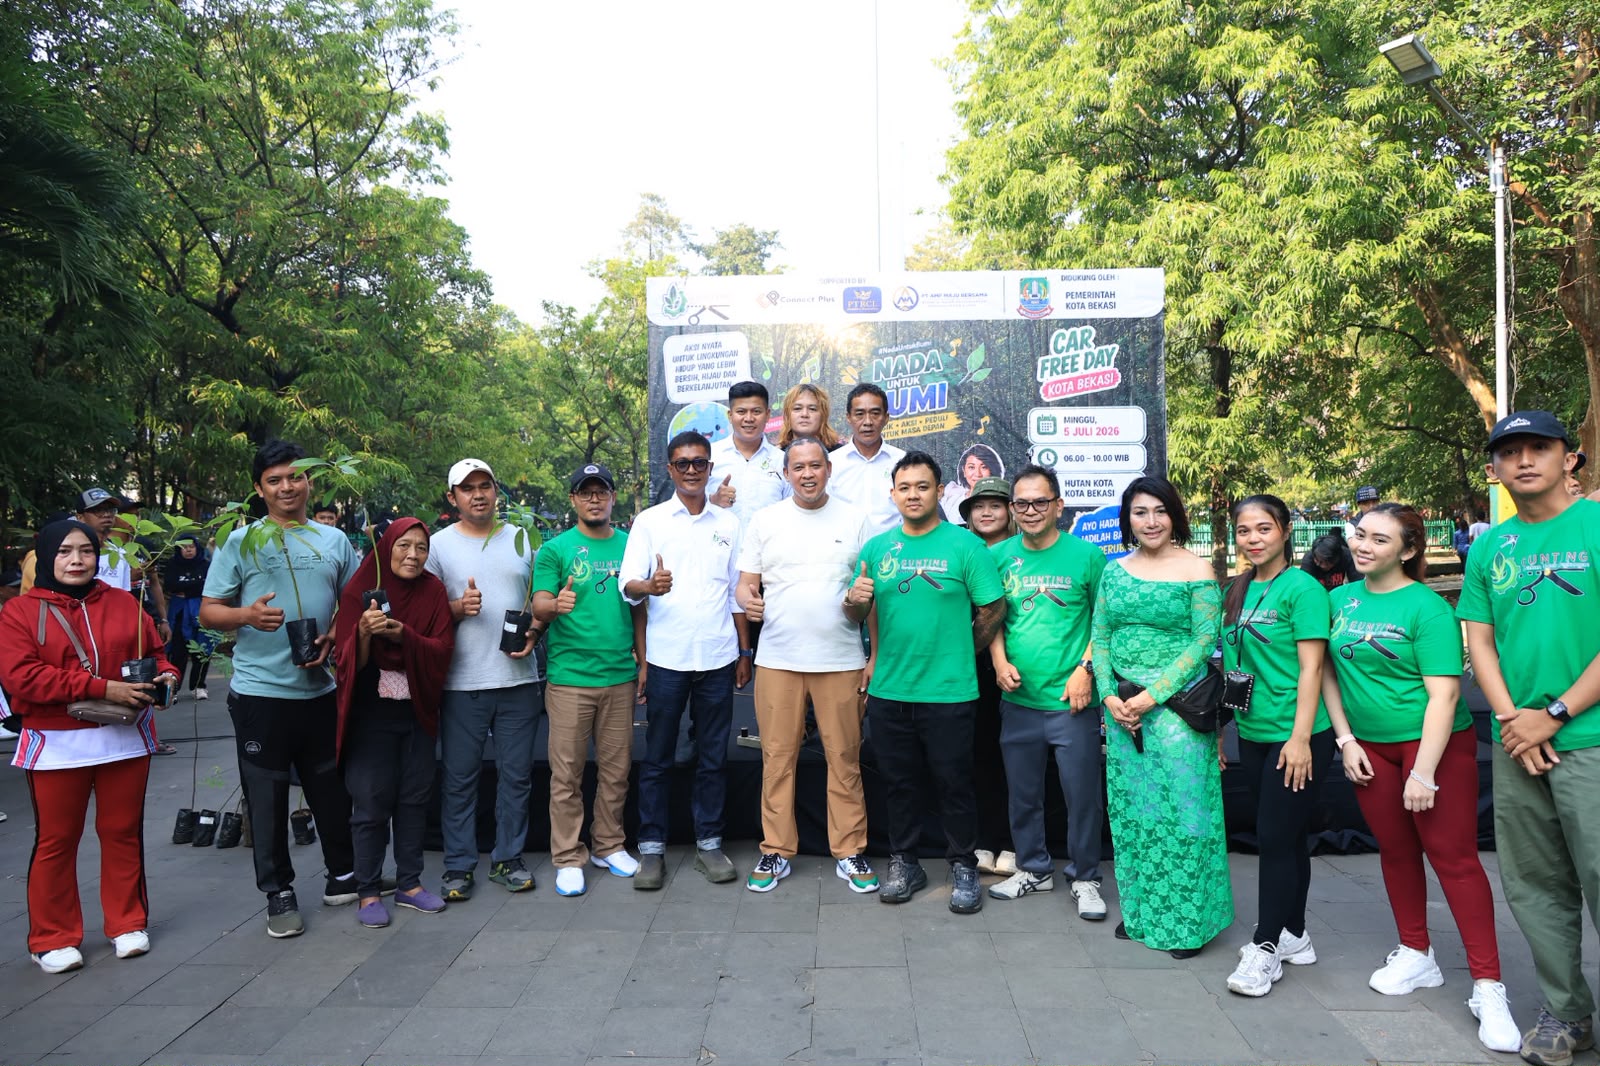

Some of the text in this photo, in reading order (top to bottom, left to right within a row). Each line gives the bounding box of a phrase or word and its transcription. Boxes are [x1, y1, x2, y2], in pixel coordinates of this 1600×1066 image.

[1060, 274, 1096, 282] DIDUKUNG
[1098, 273, 1115, 281] OLEH
[818, 295, 835, 303] Plus
[1065, 291, 1116, 299] PEMERINTAH
[1065, 301, 1117, 310] KOTA BEKASI
[684, 341, 722, 352] AKSI NYATA
[1053, 328, 1092, 355] CAR
[672, 350, 739, 363] UNTUK LINGKUNGAN
[675, 360, 736, 373] HIDUP YANG LEBIH
[873, 350, 943, 382] NADA
[1039, 346, 1116, 379] FREE DAY
[674, 370, 737, 383] BERSIH, HIJAU DAN
[887, 375, 921, 389] UNTUK
[676, 381, 732, 393] BERKELANJUTAN
[1047, 372, 1114, 397] KOTA BEKASI
[886, 381, 949, 418] UMI
[901, 419, 917, 427] AKSI
[925, 414, 949, 424] PEDULI
[1063, 416, 1097, 424] MINGGU,
[881, 423, 945, 438] NTUK MASA DEPAN
[1063, 426, 1120, 437] 5 JULI 2026
[1063, 454, 1085, 462] 06.00
[1093, 454, 1112, 462] 10.00
[1114, 454, 1130, 462] WIB
[1064, 479, 1114, 487] HUTAN KOTA
[1065, 489, 1115, 498] KOTA BEKASI
[1082, 521, 1097, 531] AYO
[1113, 530, 1123, 540] BA
[1099, 544, 1127, 555] PERUB
[901, 559, 948, 568] GUNTING
[1521, 551, 1588, 566] GUNTING
[1022, 575, 1072, 585] GUNTING
[1350, 620, 1406, 633] GUNTING
